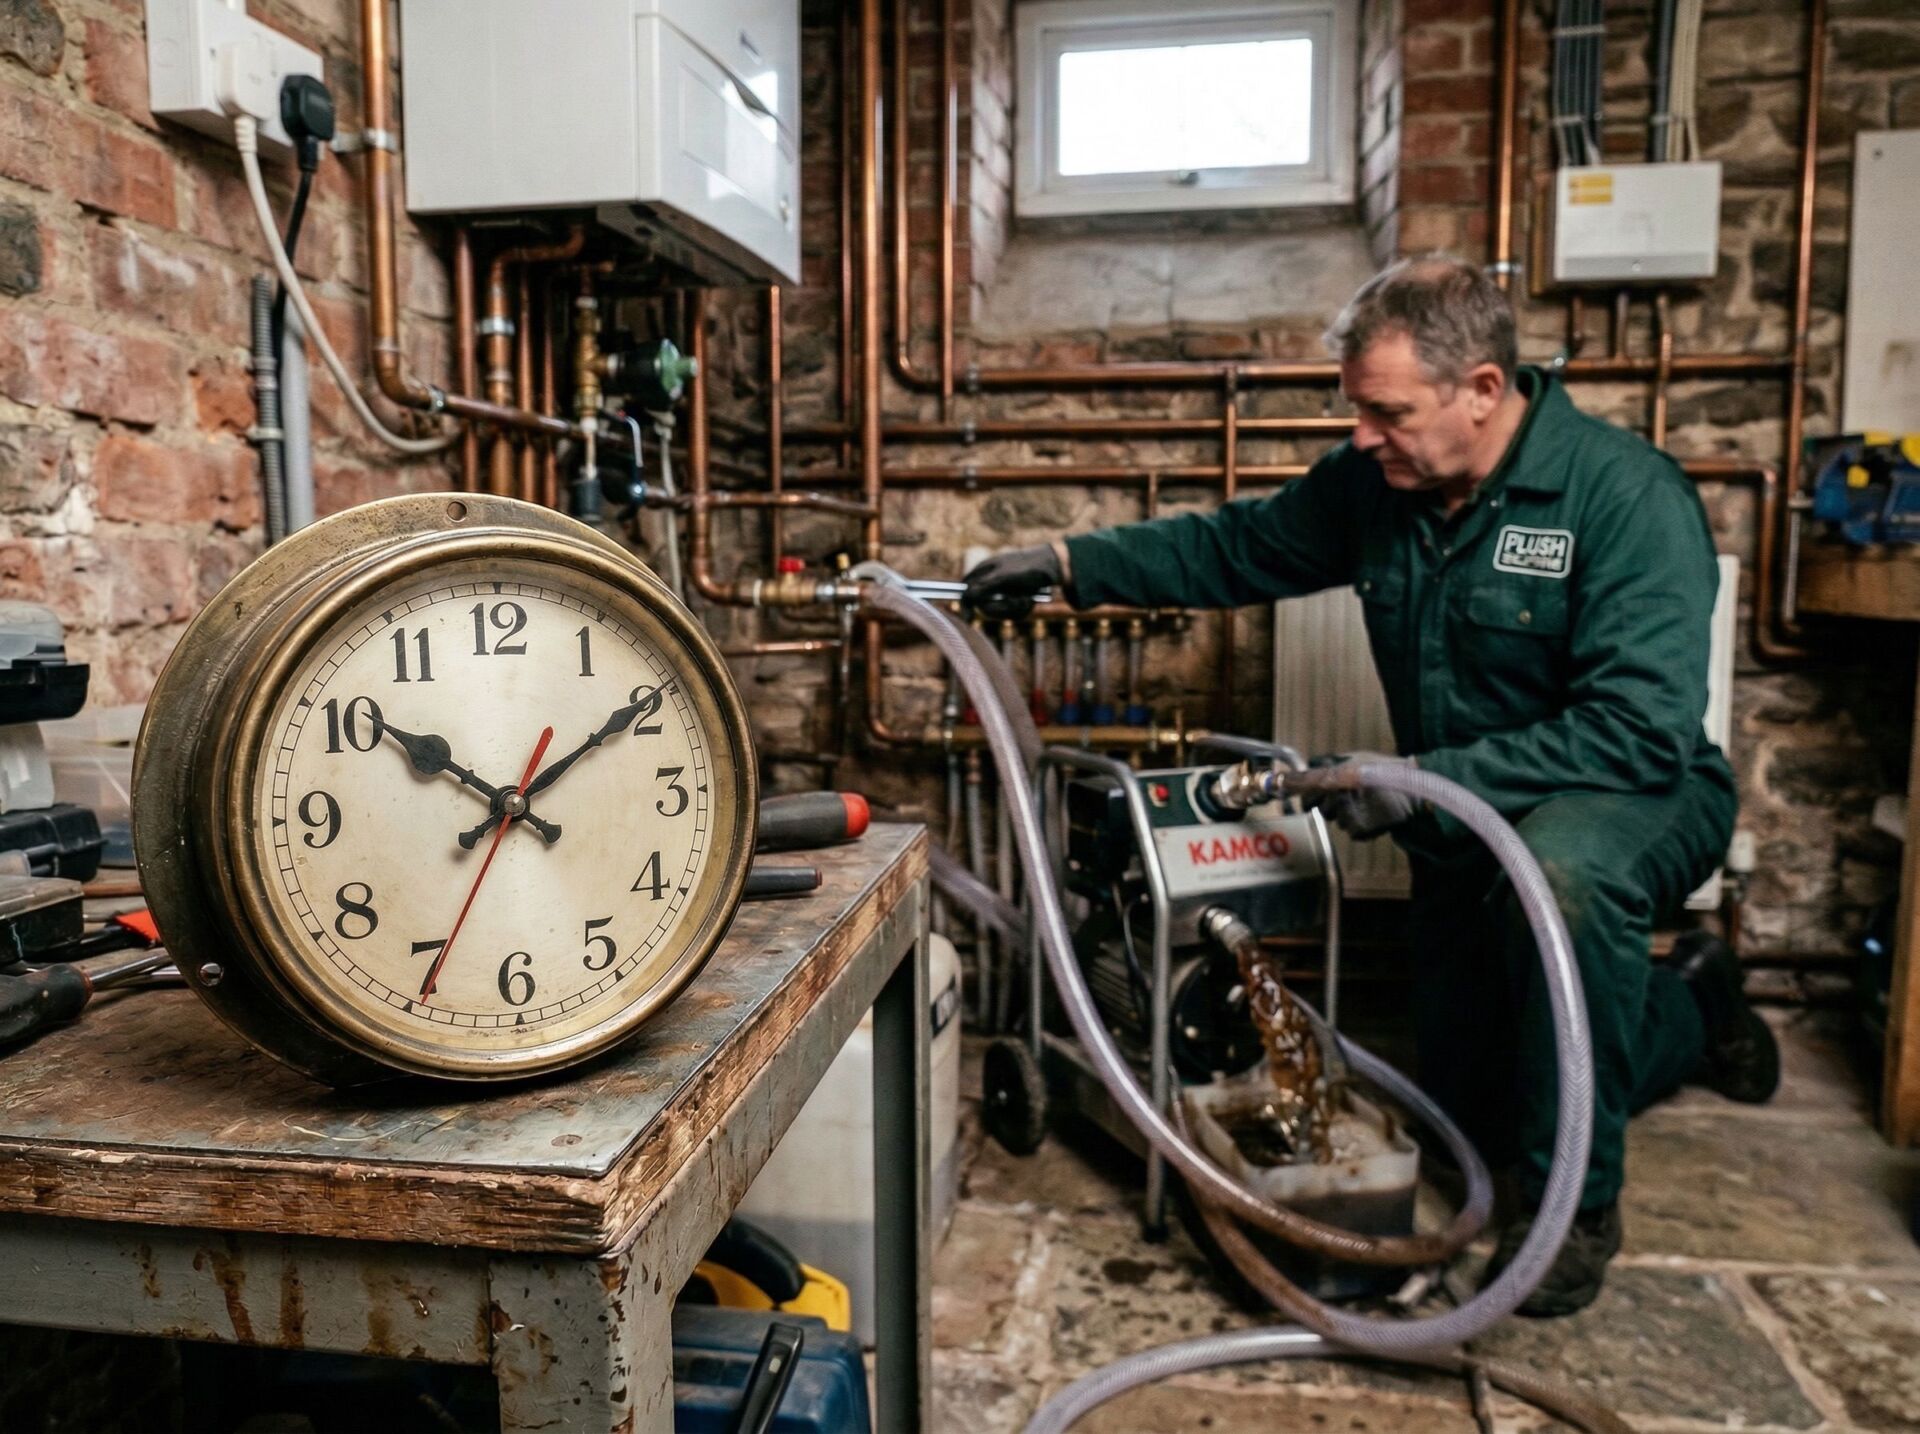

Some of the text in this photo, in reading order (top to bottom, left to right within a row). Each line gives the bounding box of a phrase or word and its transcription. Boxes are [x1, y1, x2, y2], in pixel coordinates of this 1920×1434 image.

[1504, 532, 1566, 557] PLUSH
[389, 626, 435, 683] 11
[469, 601, 528, 656] 12
[575, 625, 595, 677] 1
[321, 696, 384, 754] 10
[630, 685, 663, 736] 2
[655, 766, 689, 817] 3
[297, 790, 342, 849] 9
[630, 850, 671, 901] 4
[1188, 833, 1290, 865] KAMCO
[334, 881, 379, 940] 8
[410, 938, 449, 995] 7
[583, 915, 617, 971] 5
[498, 951, 536, 1006] 6
